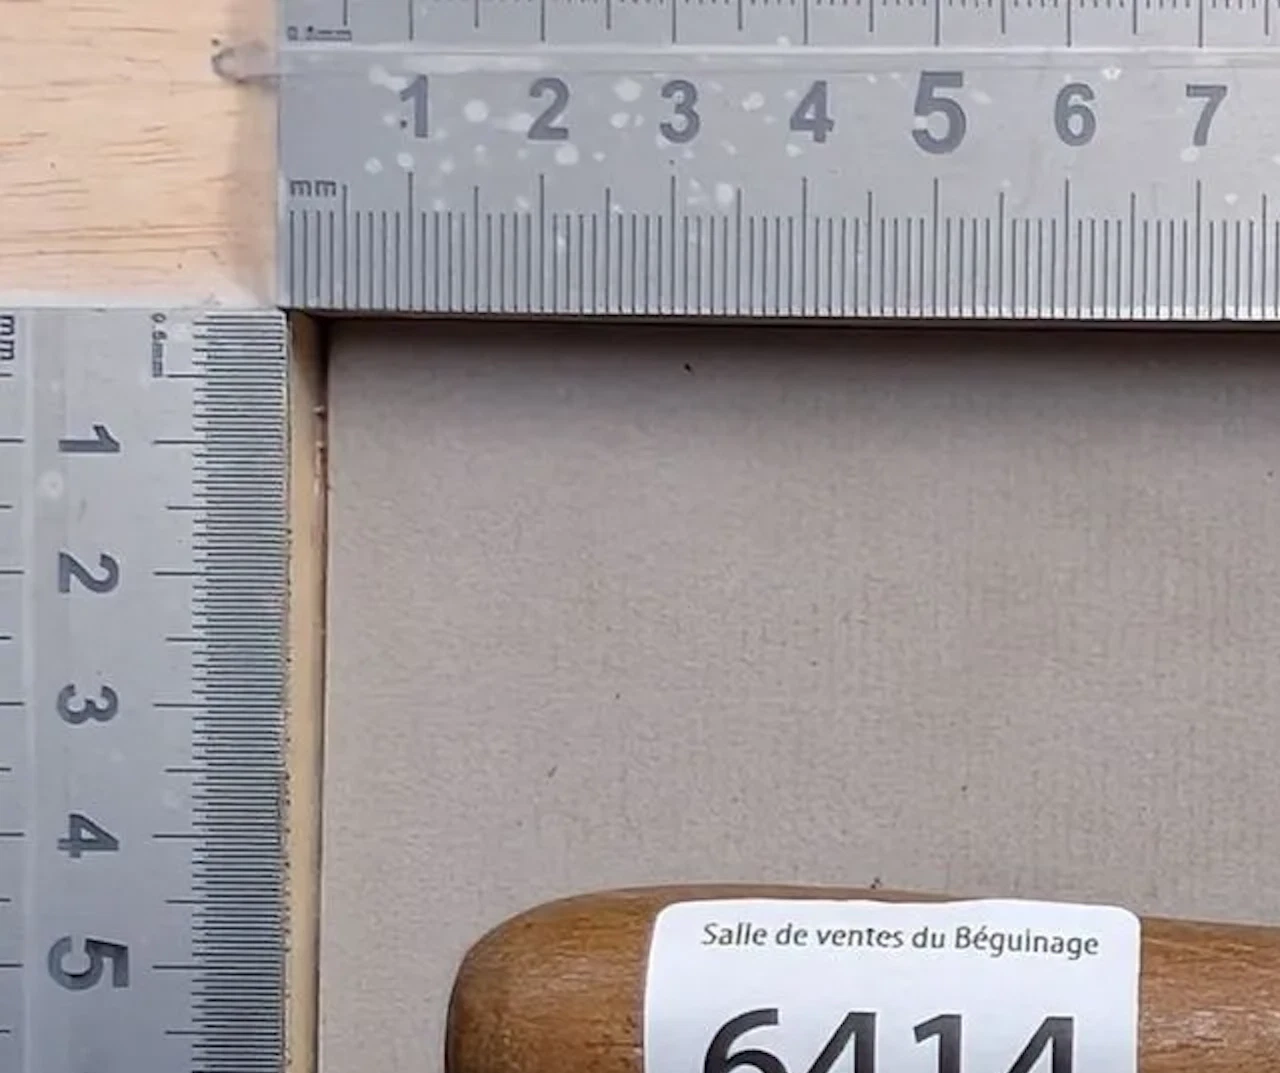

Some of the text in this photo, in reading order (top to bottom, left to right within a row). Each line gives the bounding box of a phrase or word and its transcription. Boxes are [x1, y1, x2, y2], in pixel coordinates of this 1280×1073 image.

[400, 74, 428, 138] 1
[528, 78, 569, 140] 2
[660, 80, 700, 143] 3
[790, 80, 834, 143] 4
[912, 70, 966, 154] 5
[1054, 83, 1096, 146] 6
[1186, 84, 1227, 146] 7
[290, 180, 336, 196] mm
[56, 424, 121, 454] 1
[57, 550, 119, 594] 2
[55, 683, 119, 725] 3
[56, 813, 120, 859] 4
[701, 922, 1099, 961] Salle de ventes du Béguinage
[47, 936, 130, 991] 5
